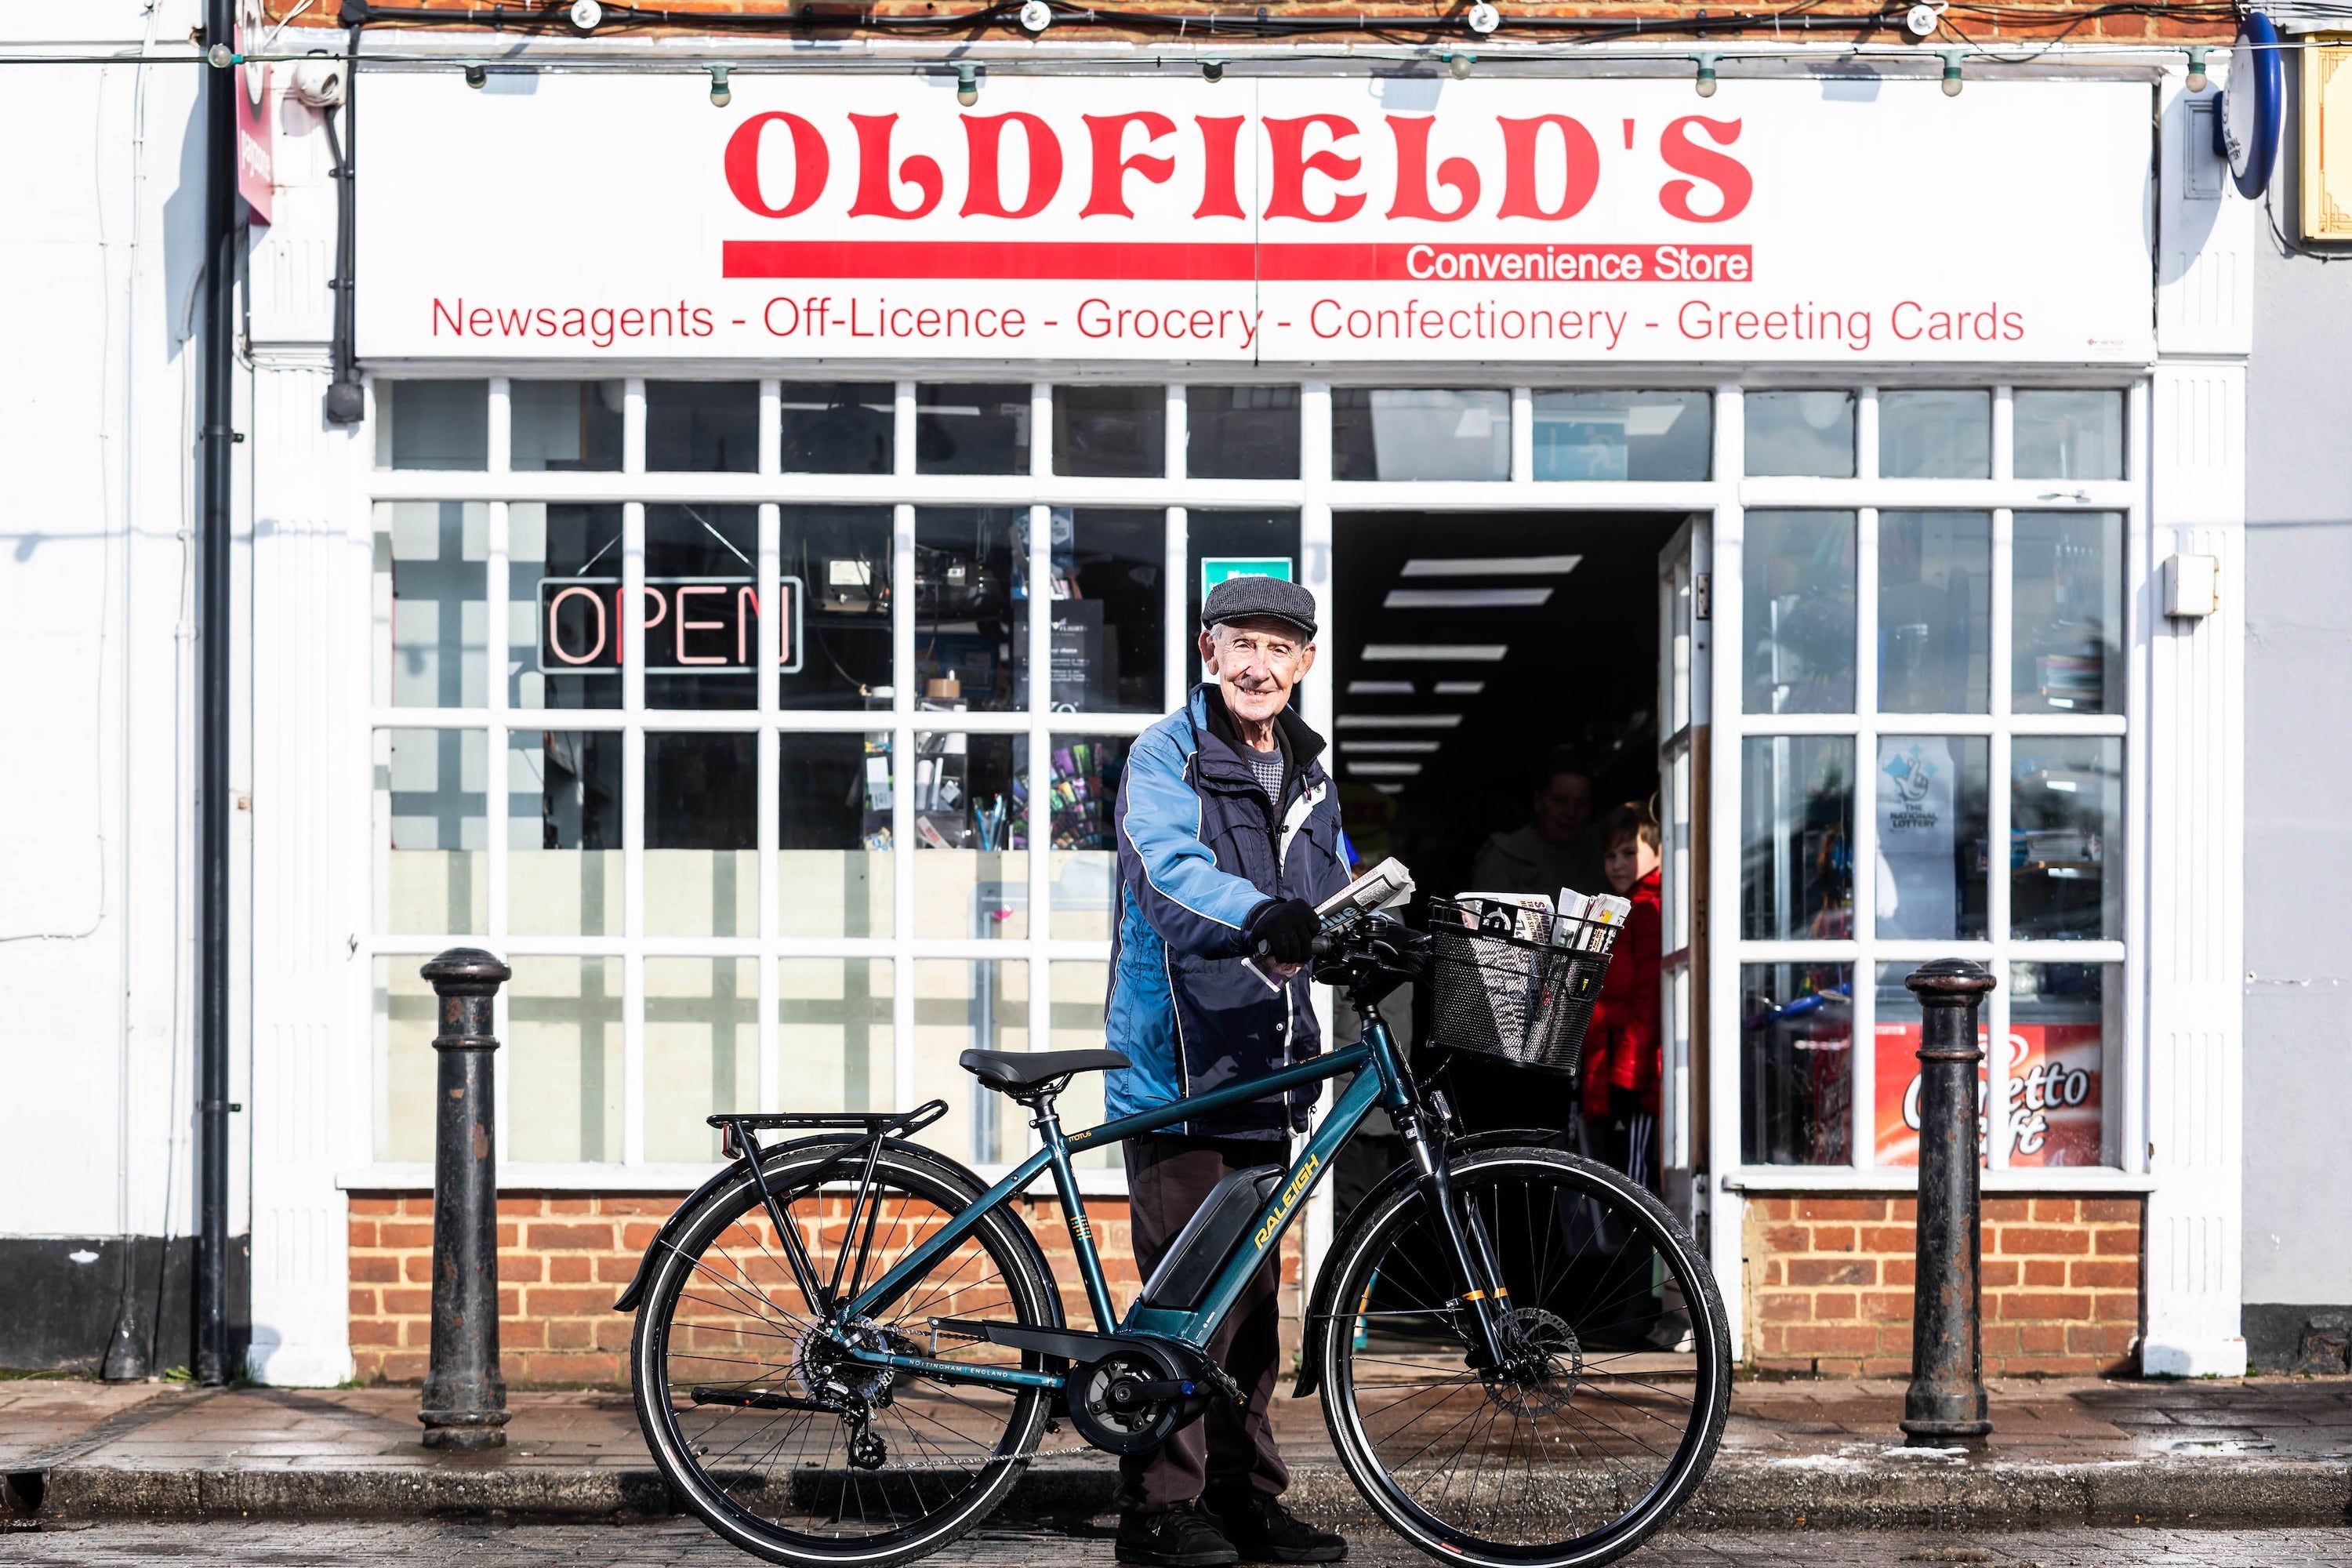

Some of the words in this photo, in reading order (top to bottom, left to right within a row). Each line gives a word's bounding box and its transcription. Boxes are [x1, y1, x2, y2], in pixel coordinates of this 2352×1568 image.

[724, 111, 1753, 224] OLDFIELD'S
[1406, 245, 1642, 280] Convenience
[1653, 245, 1748, 281] Store
[433, 298, 713, 348] Newsagents
[764, 296, 1025, 339] Off-Licence
[1077, 298, 1264, 351] Grocery
[1310, 299, 1627, 351] Confectionery
[1679, 300, 1871, 351] Greeting
[1892, 301, 2024, 342] Cards
[550, 586, 789, 665] OPEN
[1890, 811, 1937, 820] NATIONAL
[1893, 819, 1936, 828] LOTTERY
[1527, 901, 1543, 931] TRSPORT
[1482, 935, 1507, 944] TOPEAK
[1903, 1062, 2090, 1131] Cetto
[1254, 1153, 1319, 1250] RALEIGH
[970, 1366, 1009, 1378] ENGLAND
